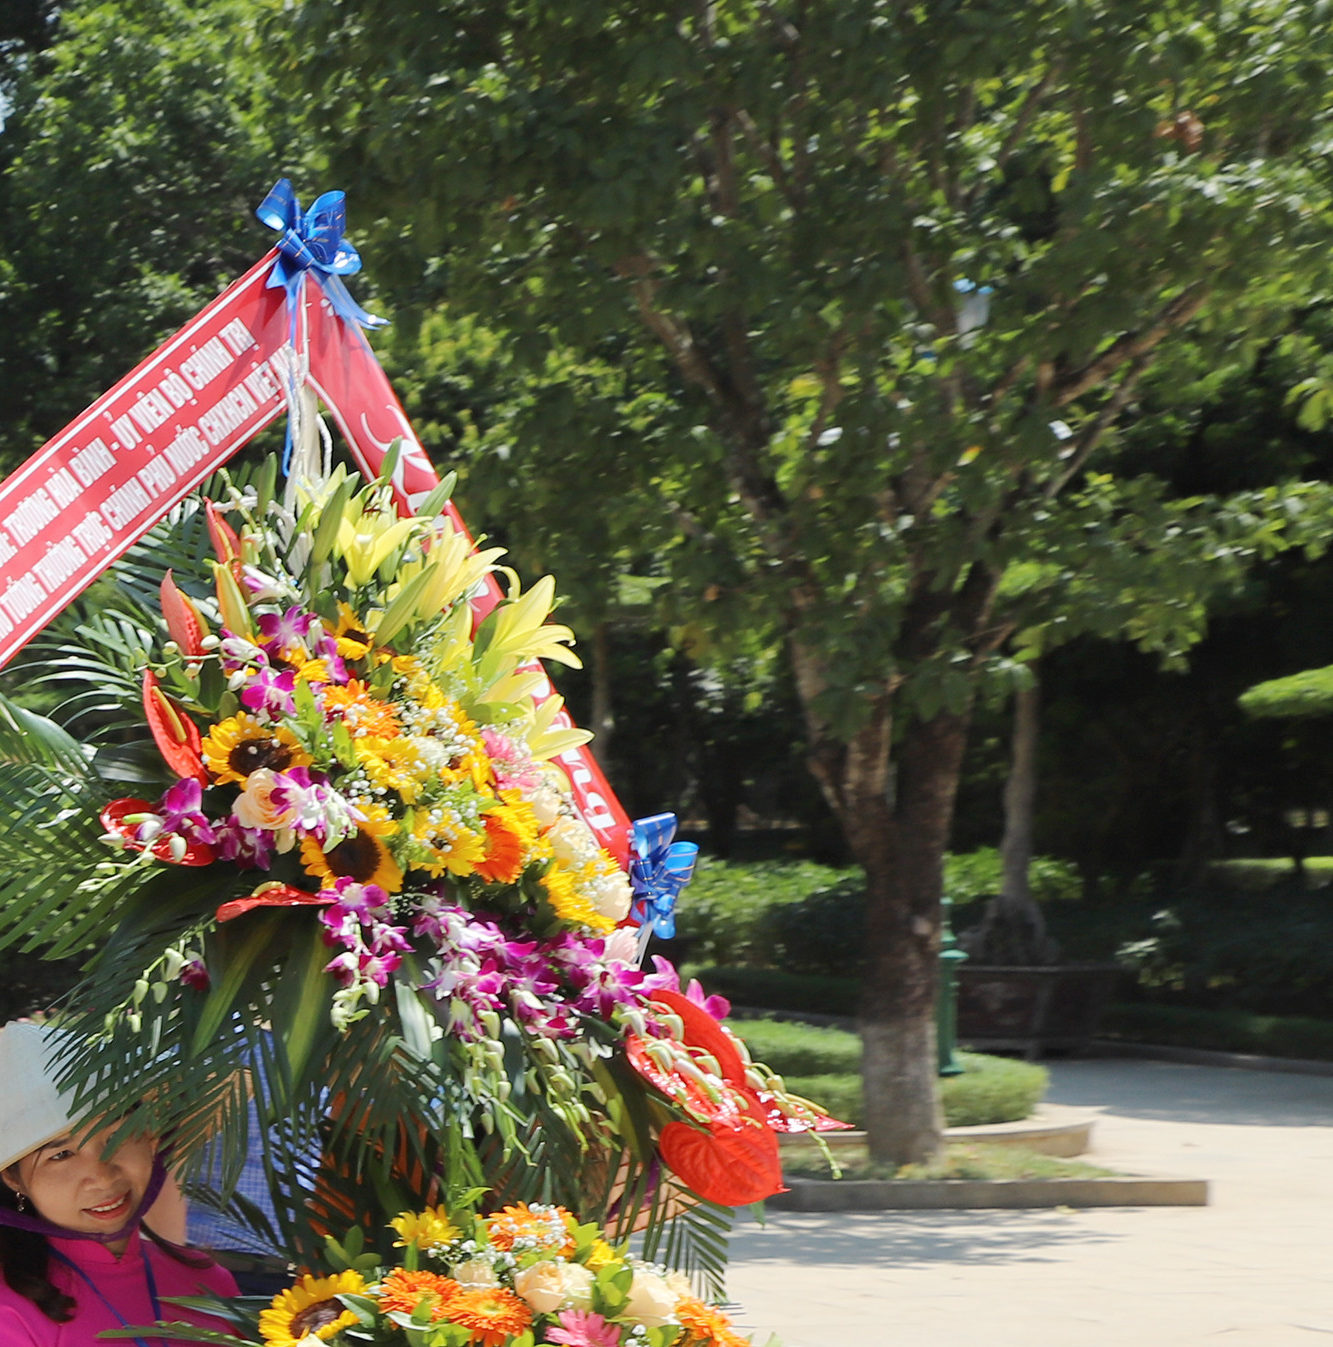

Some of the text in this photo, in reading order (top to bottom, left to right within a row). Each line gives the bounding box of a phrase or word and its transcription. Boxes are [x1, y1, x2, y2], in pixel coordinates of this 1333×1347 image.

[32, 535, 88, 593] THƯỜNG
[71, 510, 114, 557] TRỰC
[99, 477, 153, 531] CHÍNH
[137, 444, 177, 499] PHỦ
[163, 424, 210, 476] NƯỚC
[198, 383, 259, 446] CHXHCN
[243, 360, 282, 405] VIỆT
[44, 466, 84, 510] HÒA
[68, 437, 117, 489] BÌNH
[103, 411, 143, 450] ỦY
[128, 388, 176, 434] VIÊN
[158, 368, 198, 408] BỘ
[179, 336, 235, 390] CHÍNH
[218, 317, 260, 357] TRỊ
